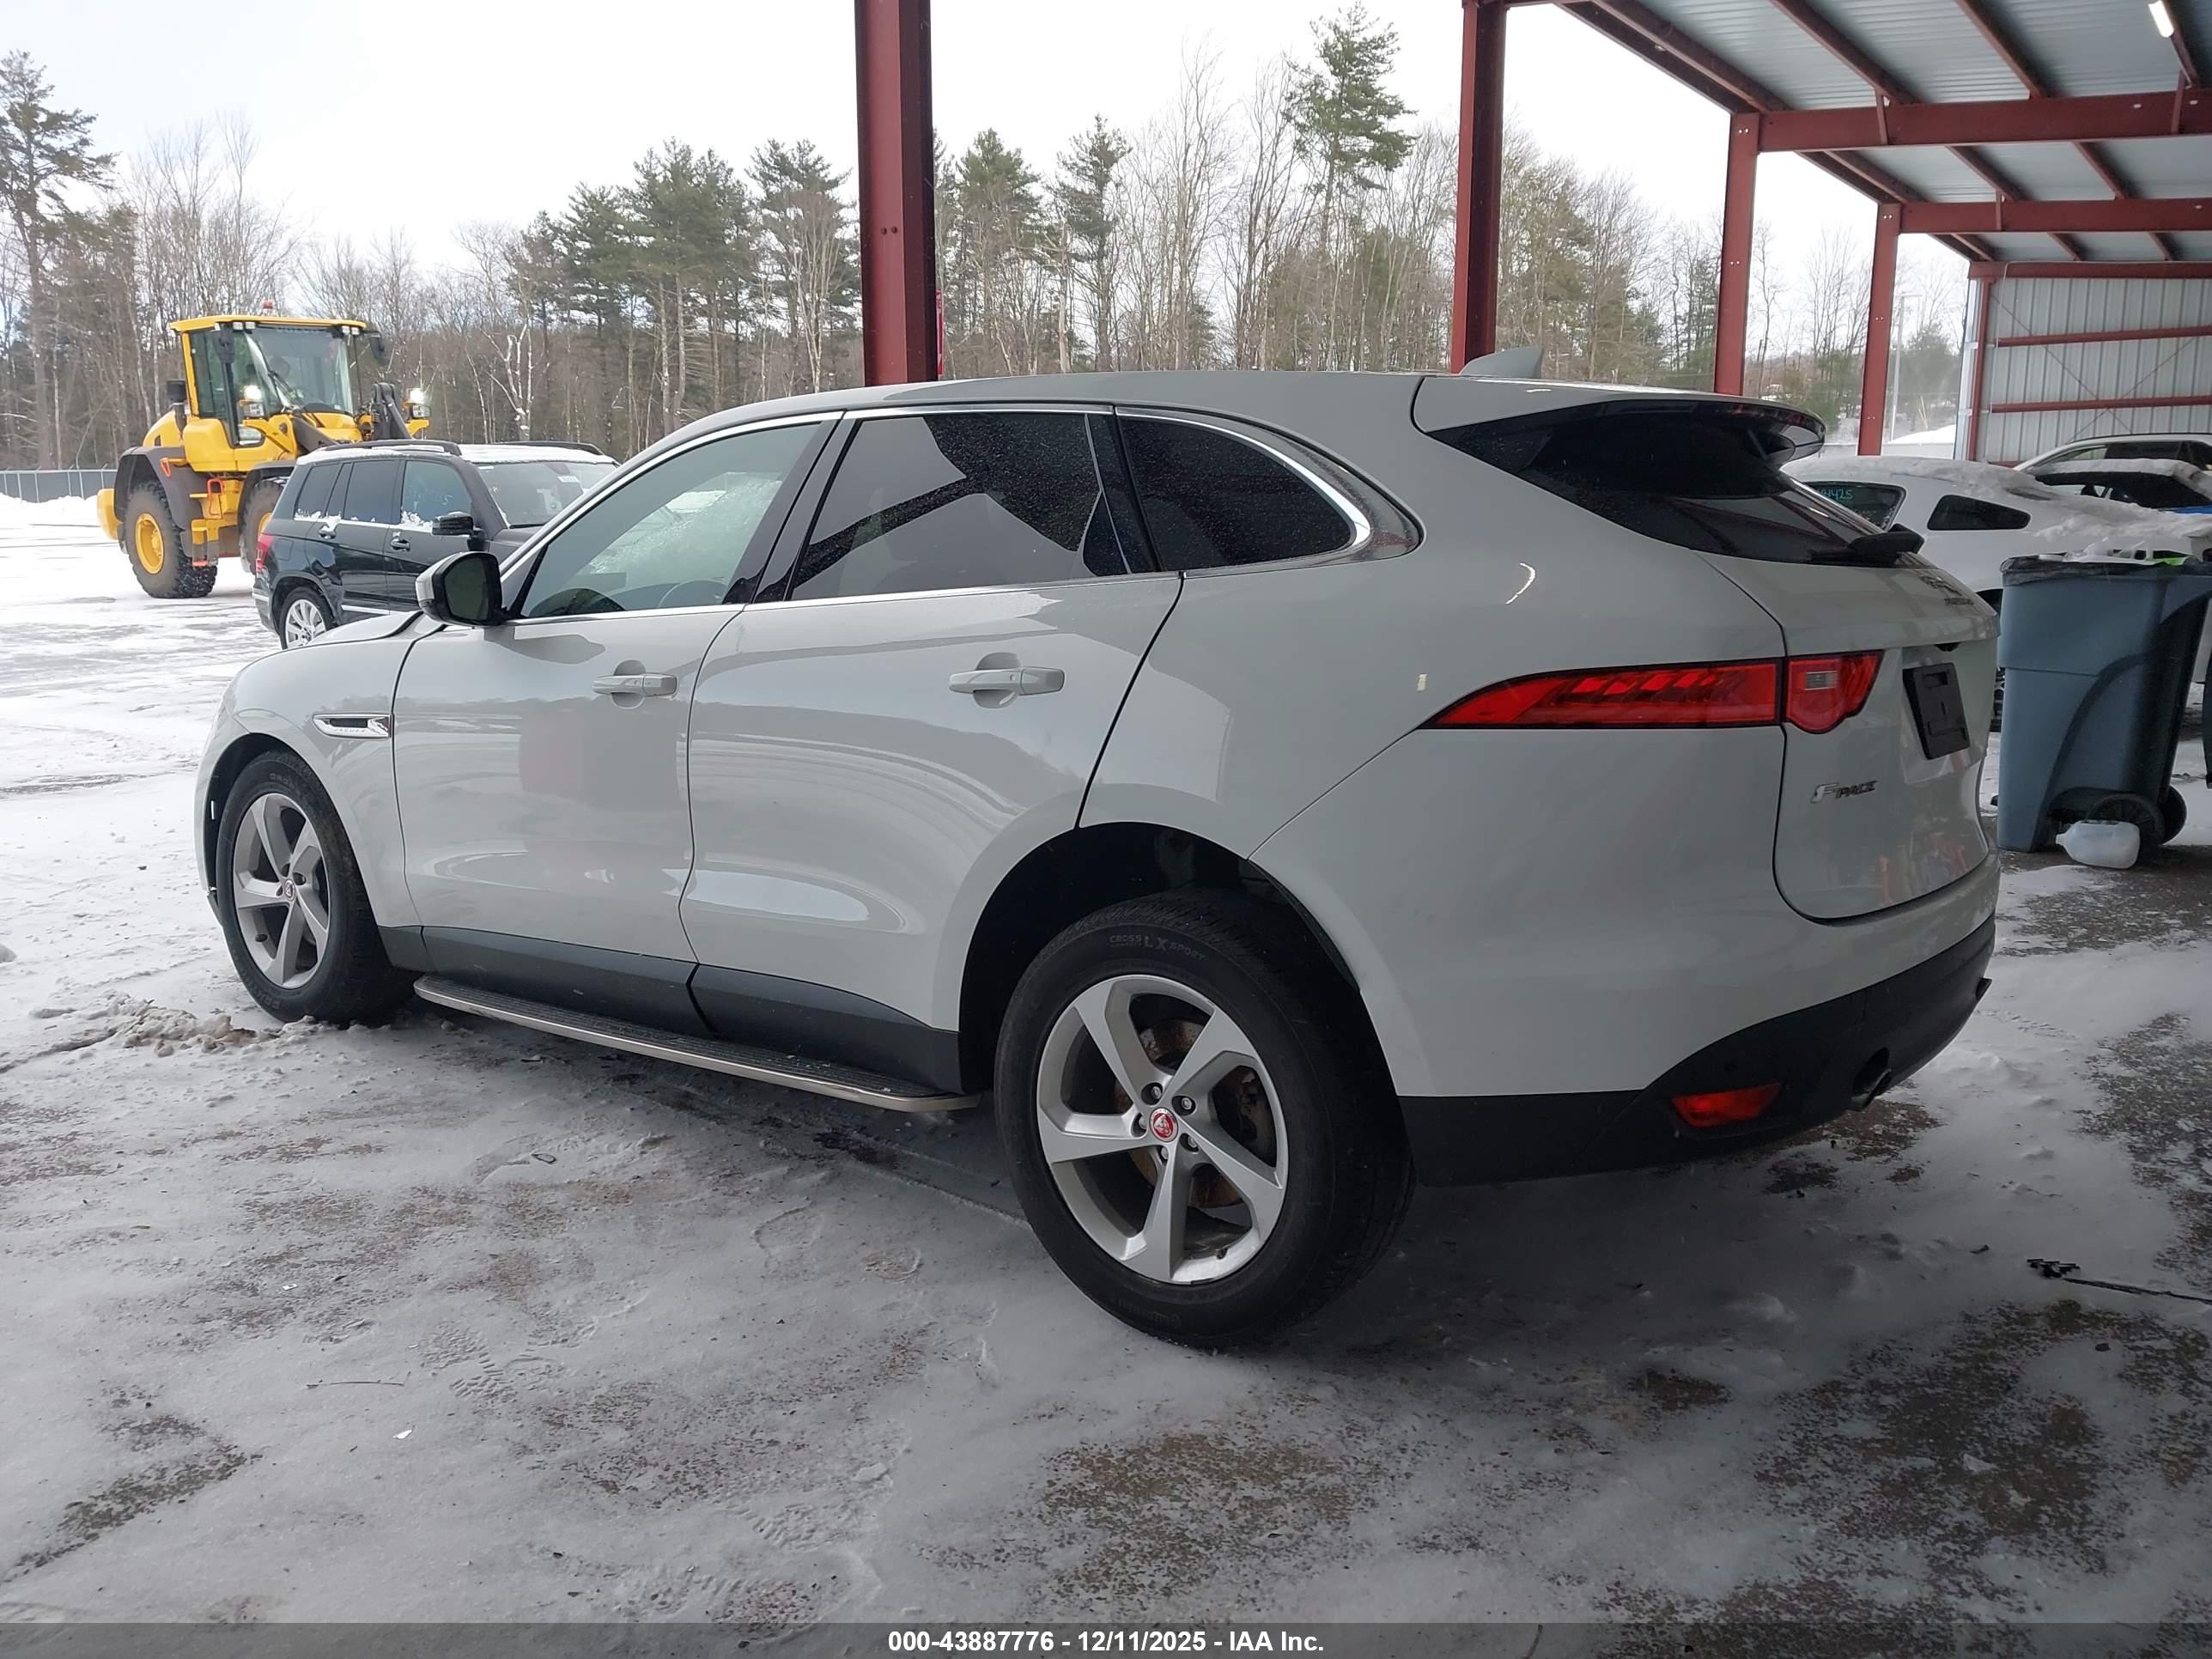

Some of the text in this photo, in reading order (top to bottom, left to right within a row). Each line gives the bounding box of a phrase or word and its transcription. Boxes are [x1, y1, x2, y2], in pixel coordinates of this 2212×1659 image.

[1109, 934, 1206, 961] CROSS LX SPORT
